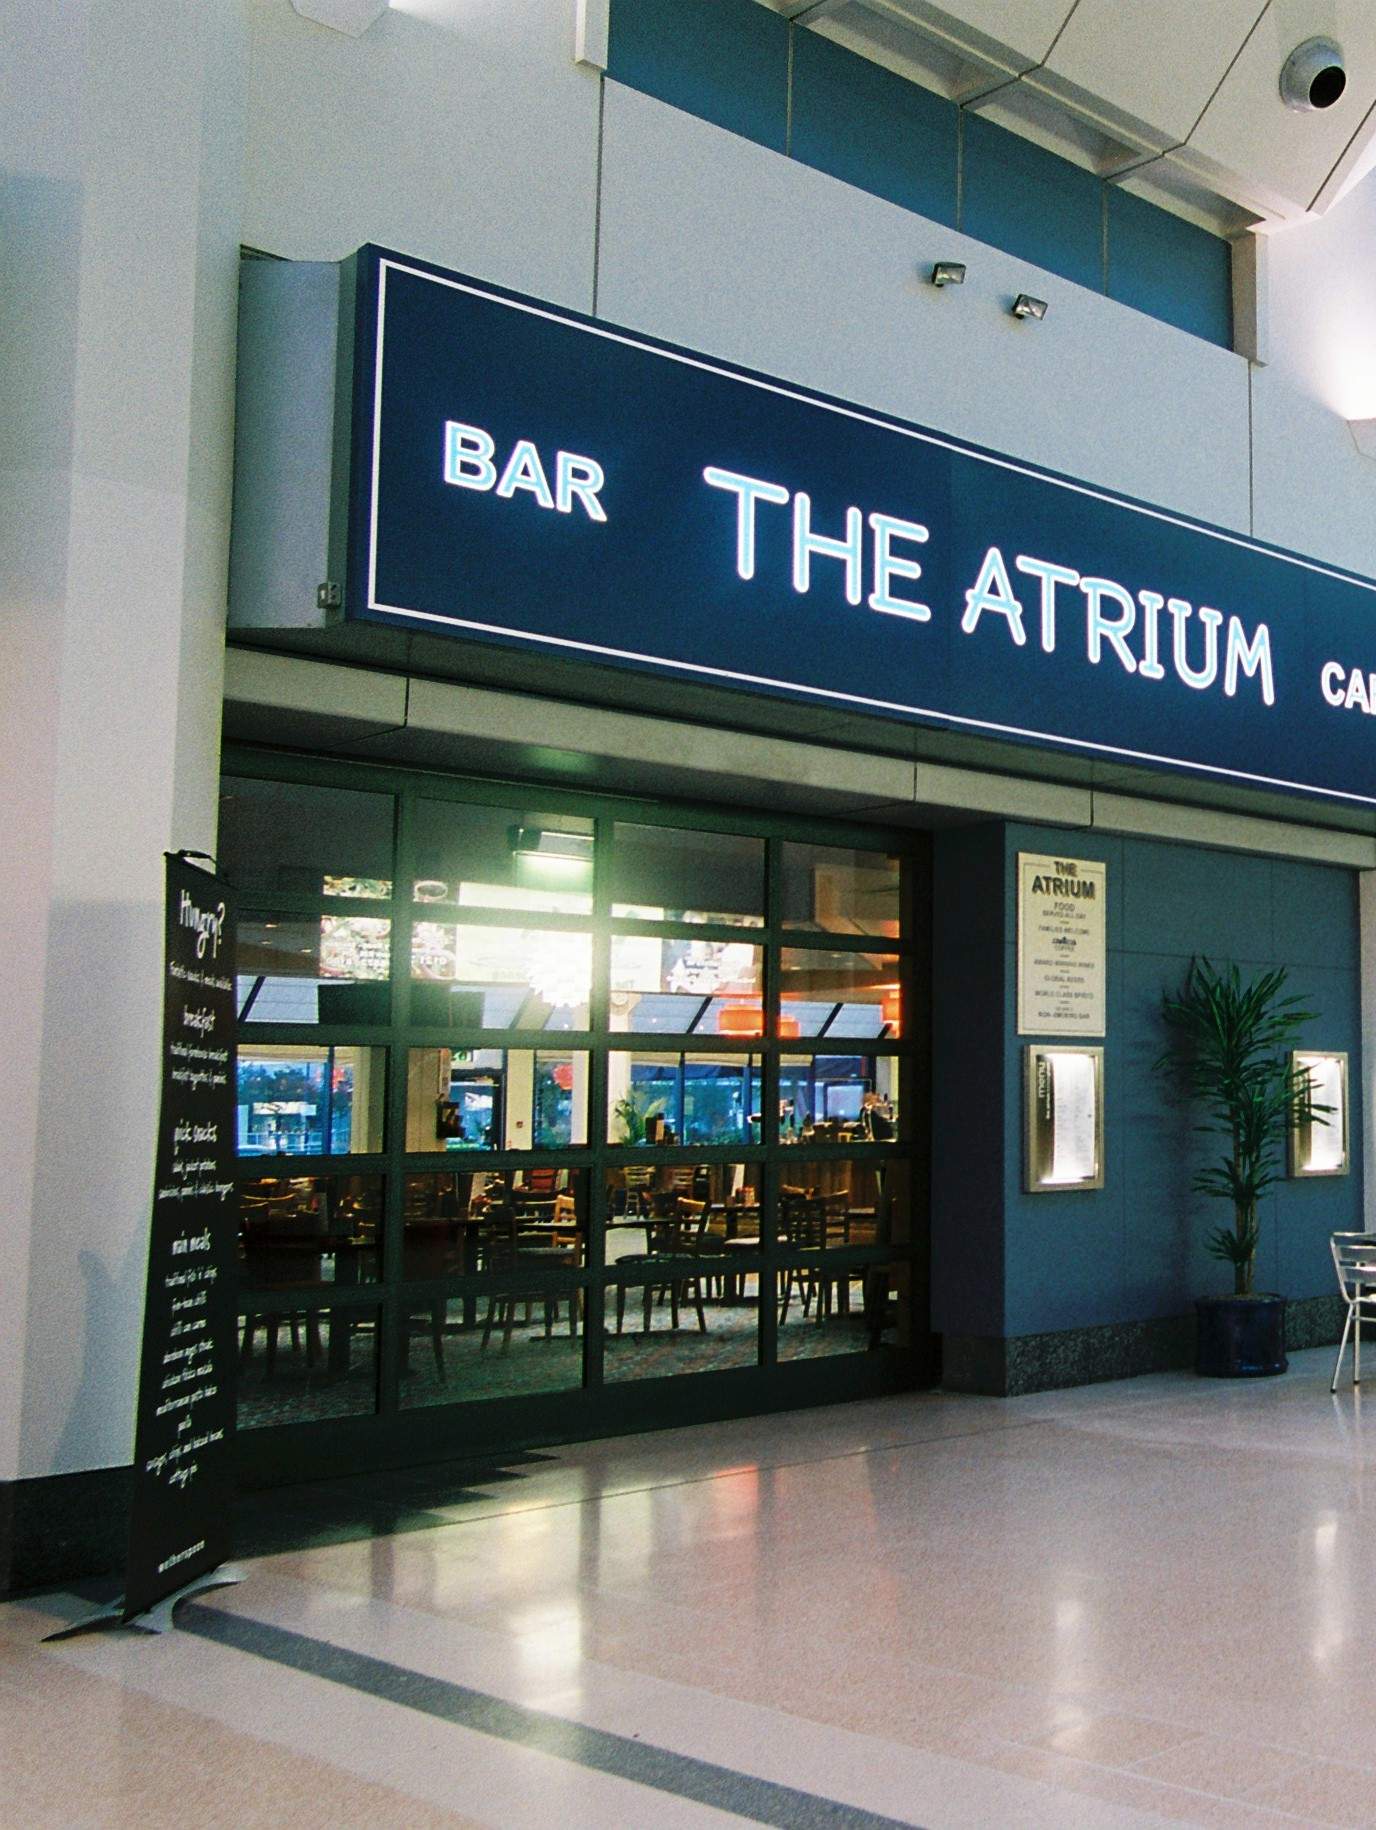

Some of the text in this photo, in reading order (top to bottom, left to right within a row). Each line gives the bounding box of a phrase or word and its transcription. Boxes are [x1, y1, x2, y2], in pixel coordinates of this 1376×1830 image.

[441, 418, 609, 524] BAR
[702, 464, 933, 623] THE
[960, 545, 1276, 707] ATRIUM
[1054, 861, 1078, 878] THE
[1031, 874, 1096, 901] ATRIUM
[1053, 901, 1076, 913] FOOD
[179, 888, 226, 959] Hungry?
